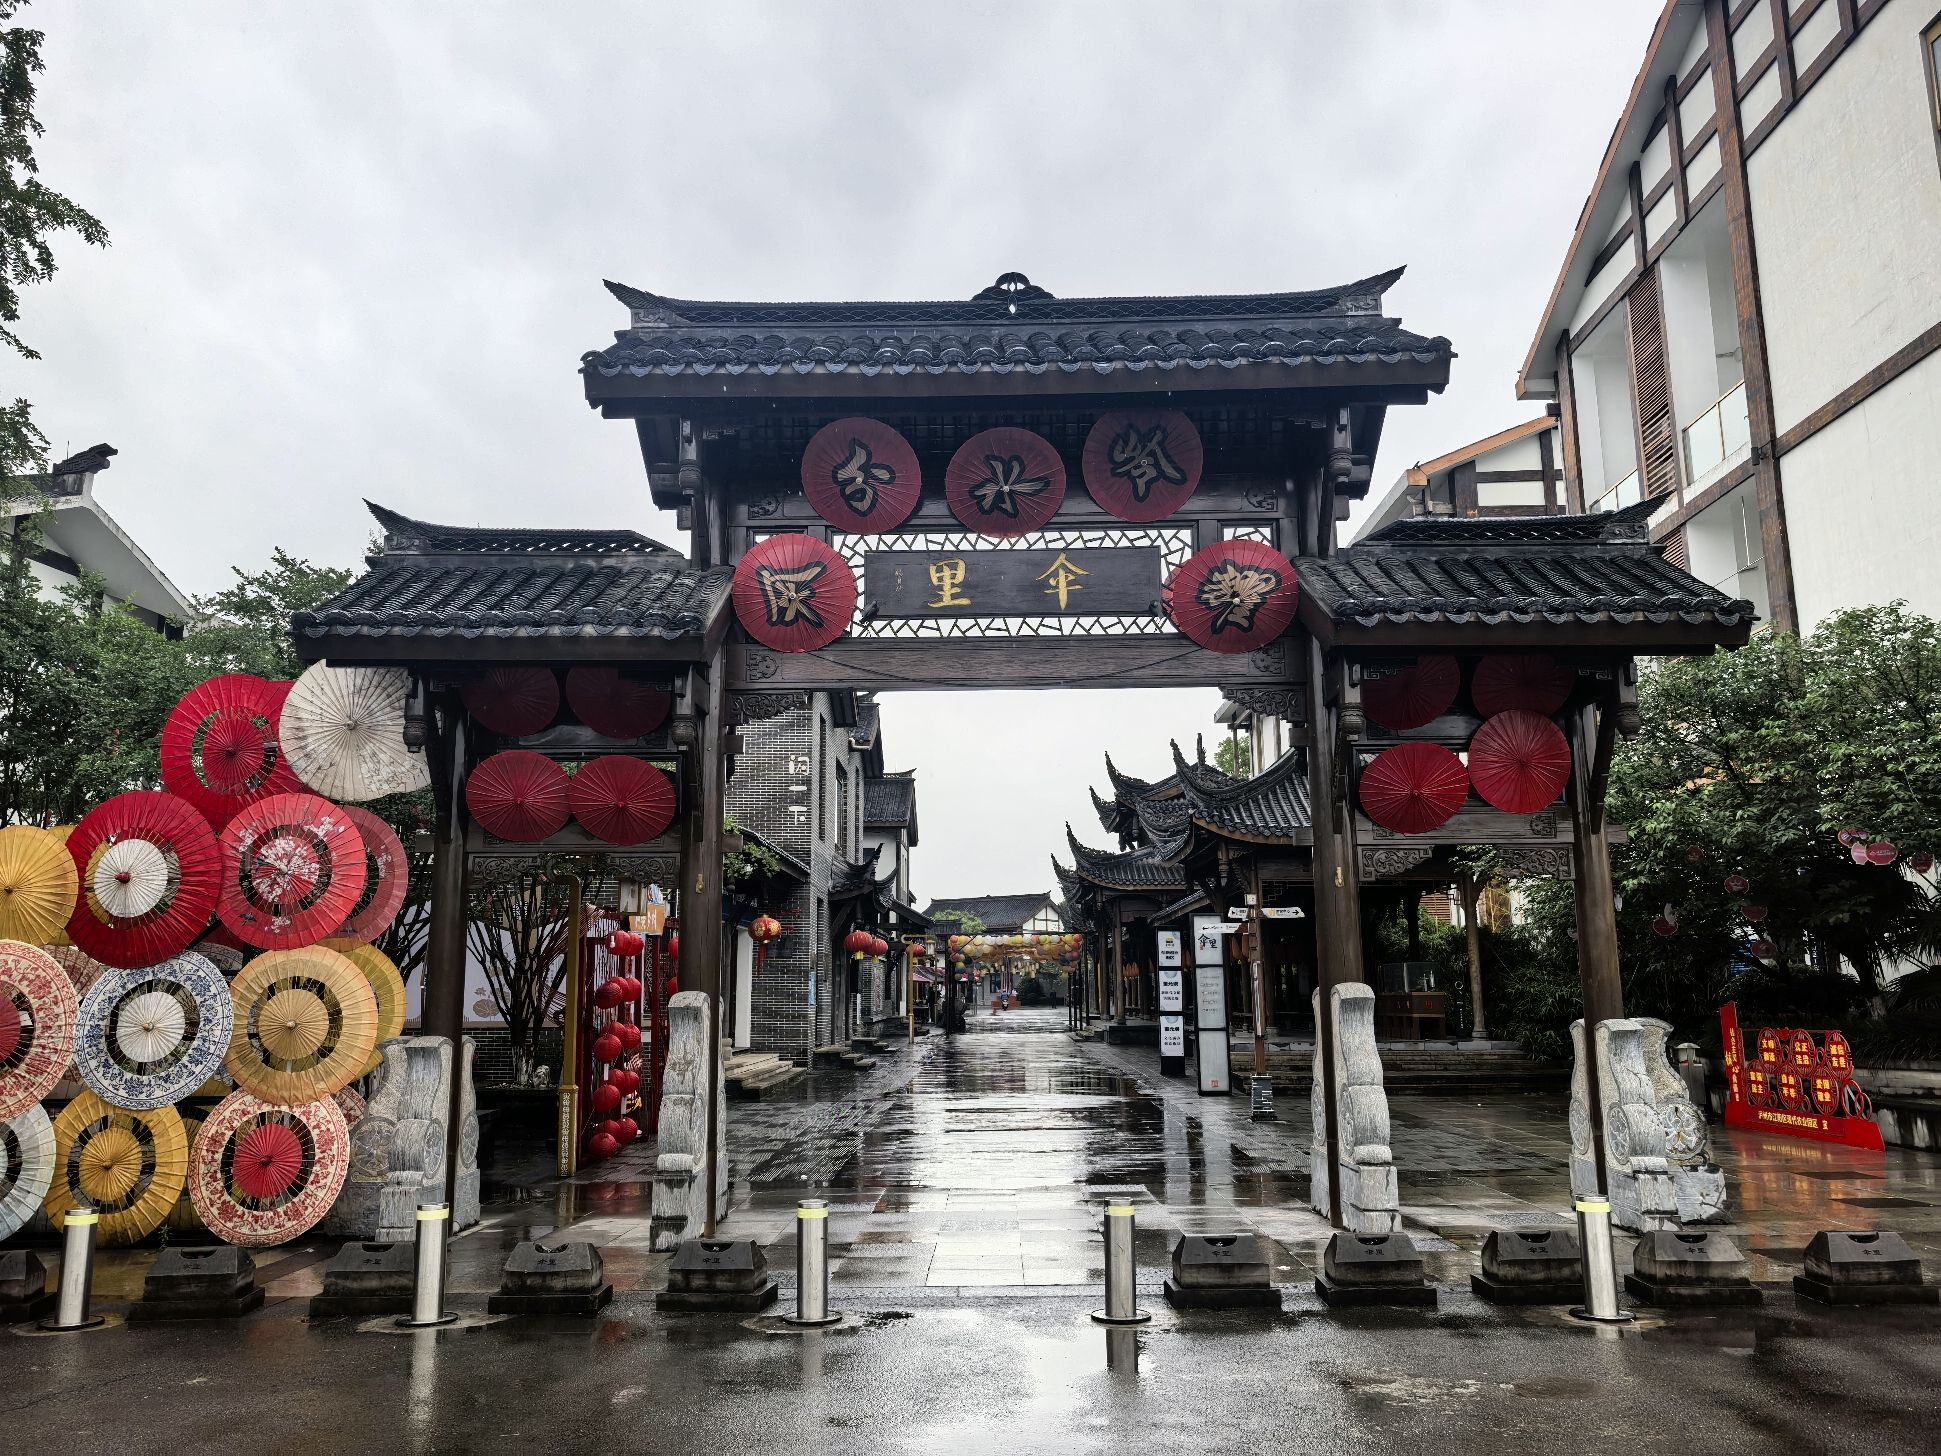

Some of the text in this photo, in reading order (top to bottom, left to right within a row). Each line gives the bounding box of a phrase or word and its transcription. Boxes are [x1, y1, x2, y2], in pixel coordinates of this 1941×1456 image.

[971, 454, 1051, 516] 水
[928, 552, 1093, 611] 伞里
[1761, 1039, 1774, 1048] 文明
[1795, 1042, 1807, 1052] 公正
[1781, 1074, 1794, 1085] 自由
